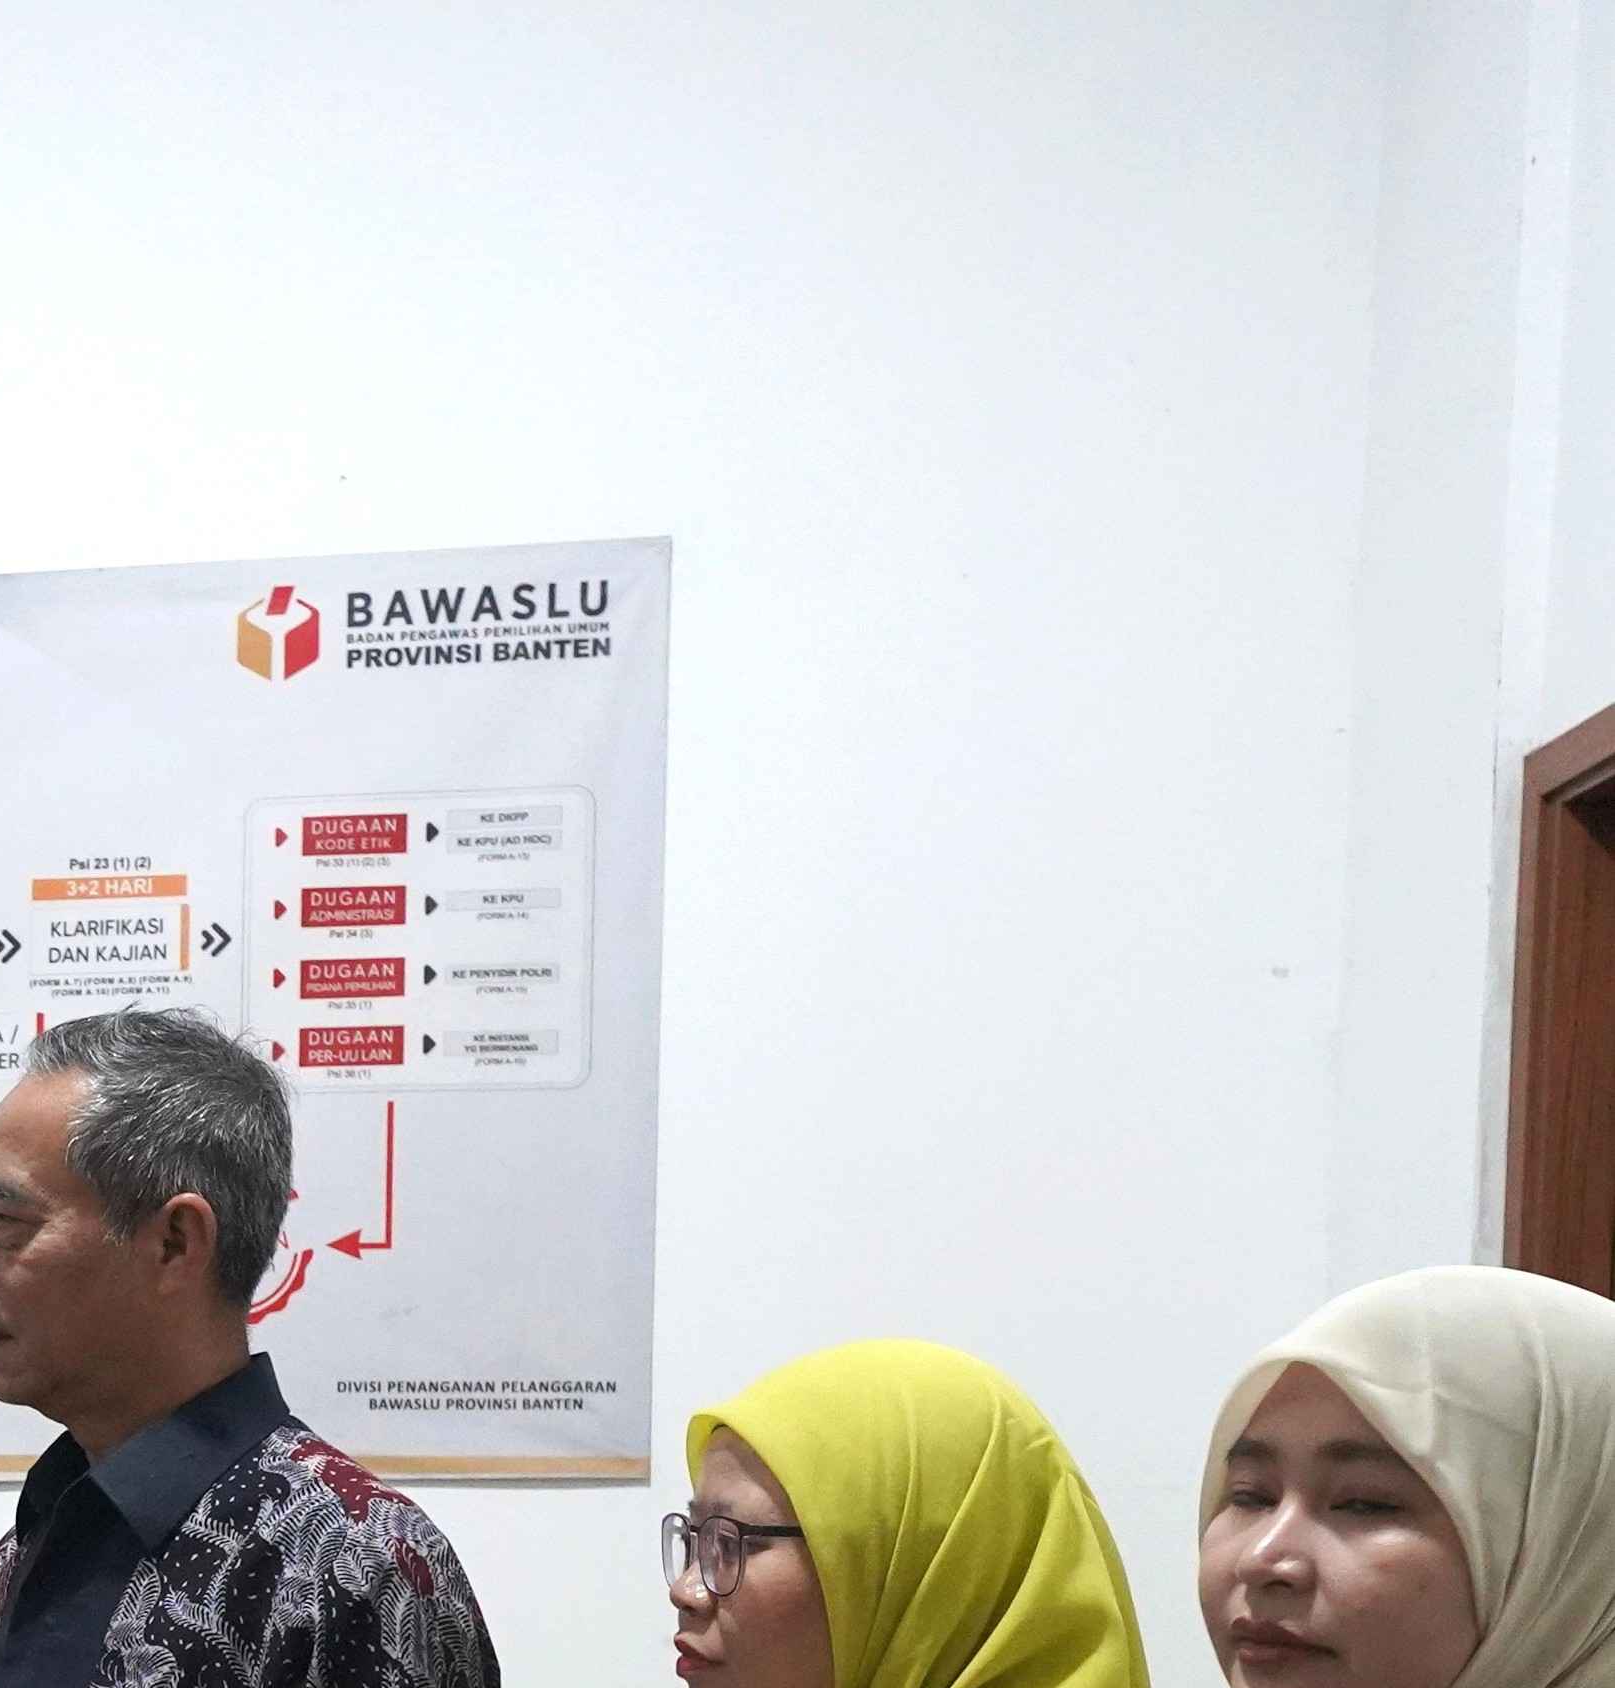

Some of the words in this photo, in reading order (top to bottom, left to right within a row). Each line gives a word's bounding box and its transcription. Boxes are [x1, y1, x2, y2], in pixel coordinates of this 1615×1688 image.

[347, 580, 608, 628] BAWASLU
[347, 632, 395, 645] BADAN
[401, 629, 479, 643] PENGAWAS
[485, 625, 563, 638] PEMILIHAN
[568, 622, 610, 634] UMUM
[347, 644, 482, 669] PROVINSI
[493, 638, 611, 662] BANTEN
[481, 814, 494, 823] KE
[311, 818, 397, 835] DUGAAN
[315, 838, 356, 850] KODE
[361, 837, 392, 849] ETIK
[457, 838, 471, 847] KE
[475, 837, 498, 846] KPU
[501, 836, 521, 846] (AD
[69, 858, 90, 870] Psl
[95, 858, 109, 870] 23
[113, 858, 130, 871] (1)
[135, 856, 152, 870] (2)
[67, 880, 99, 897] 3+2
[105, 878, 154, 895] HARI
[311, 890, 396, 907] DUGAAN
[483, 895, 497, 904] KE
[501, 894, 523, 904] KPU
[309, 909, 395, 922] ADMINISTRASI
[51, 918, 164, 938] KLARIFIKASI
[49, 946, 90, 964] DAN
[96, 944, 167, 963] KAJIAN
[309, 963, 395, 979] DUGAAN
[453, 970, 466, 979] KE
[469, 969, 517, 978] PENYIDIK
[521, 968, 552, 977] POLRI
[306, 982, 343, 993] PIDANA
[11, 1024, 19, 1045] /
[309, 1030, 394, 1046] DUGAAN
[309, 1050, 359, 1063] PER-UU
[361, 1049, 392, 1061] LAIN
[337, 1381, 381, 1393] DIVISI
[387, 1381, 496, 1393] PENANGANAN
[501, 1381, 617, 1393] PELANGGARAN
[369, 1398, 440, 1410] BAWASLU
[445, 1398, 517, 1410] PROVINSI
[523, 1398, 584, 1410] BANTEN
